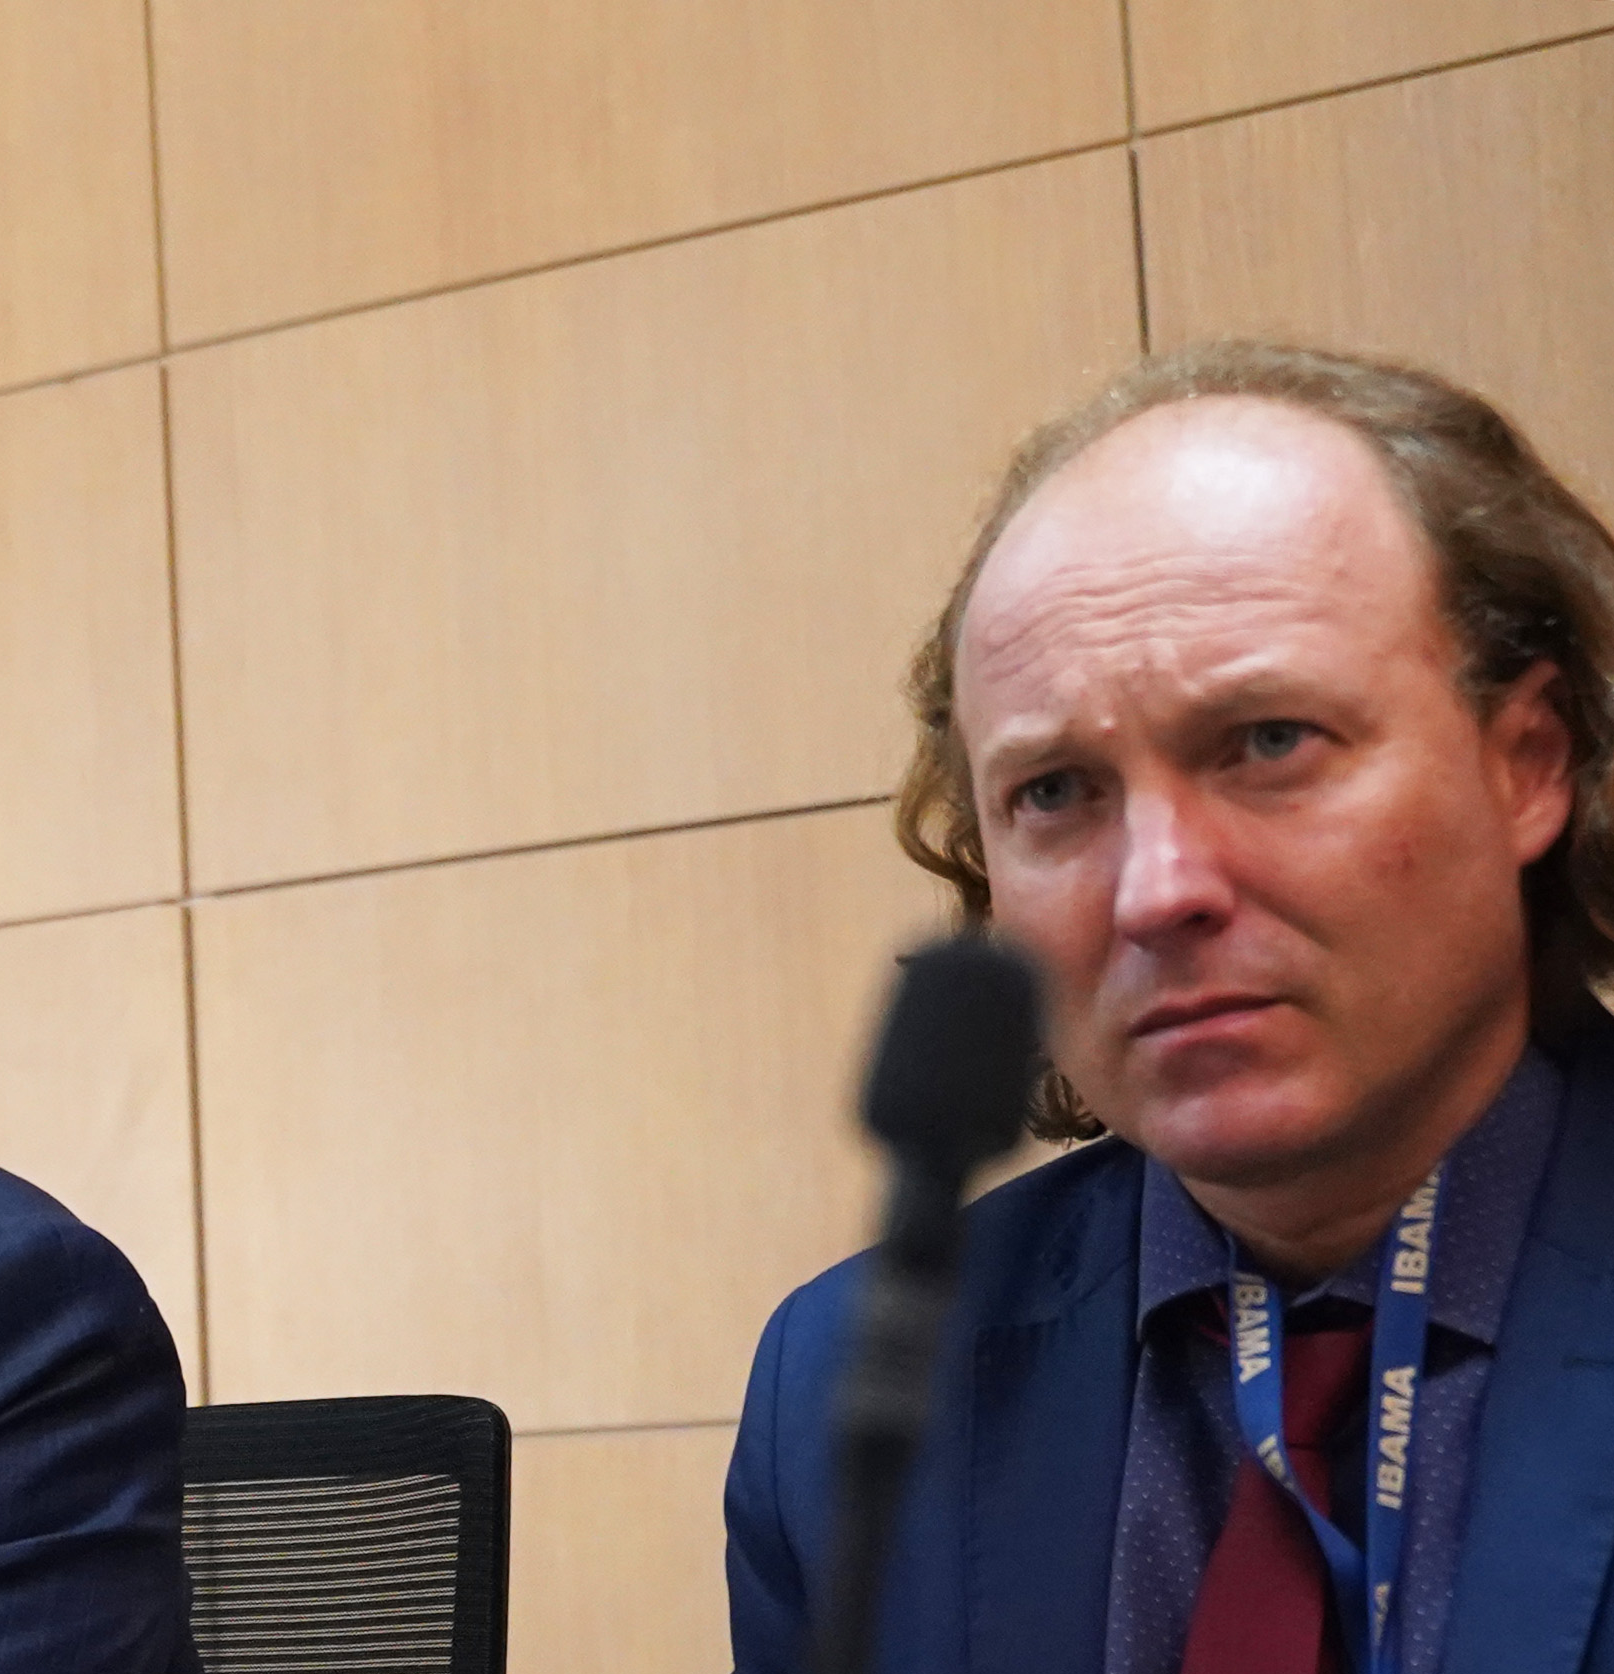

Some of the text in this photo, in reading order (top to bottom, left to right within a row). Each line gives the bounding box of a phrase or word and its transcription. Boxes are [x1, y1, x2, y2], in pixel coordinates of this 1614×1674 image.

[1390, 1164, 1441, 1295] IBAM
[1232, 1272, 1272, 1384] IBAMA
[1376, 1366, 1416, 1510] IBAMA
